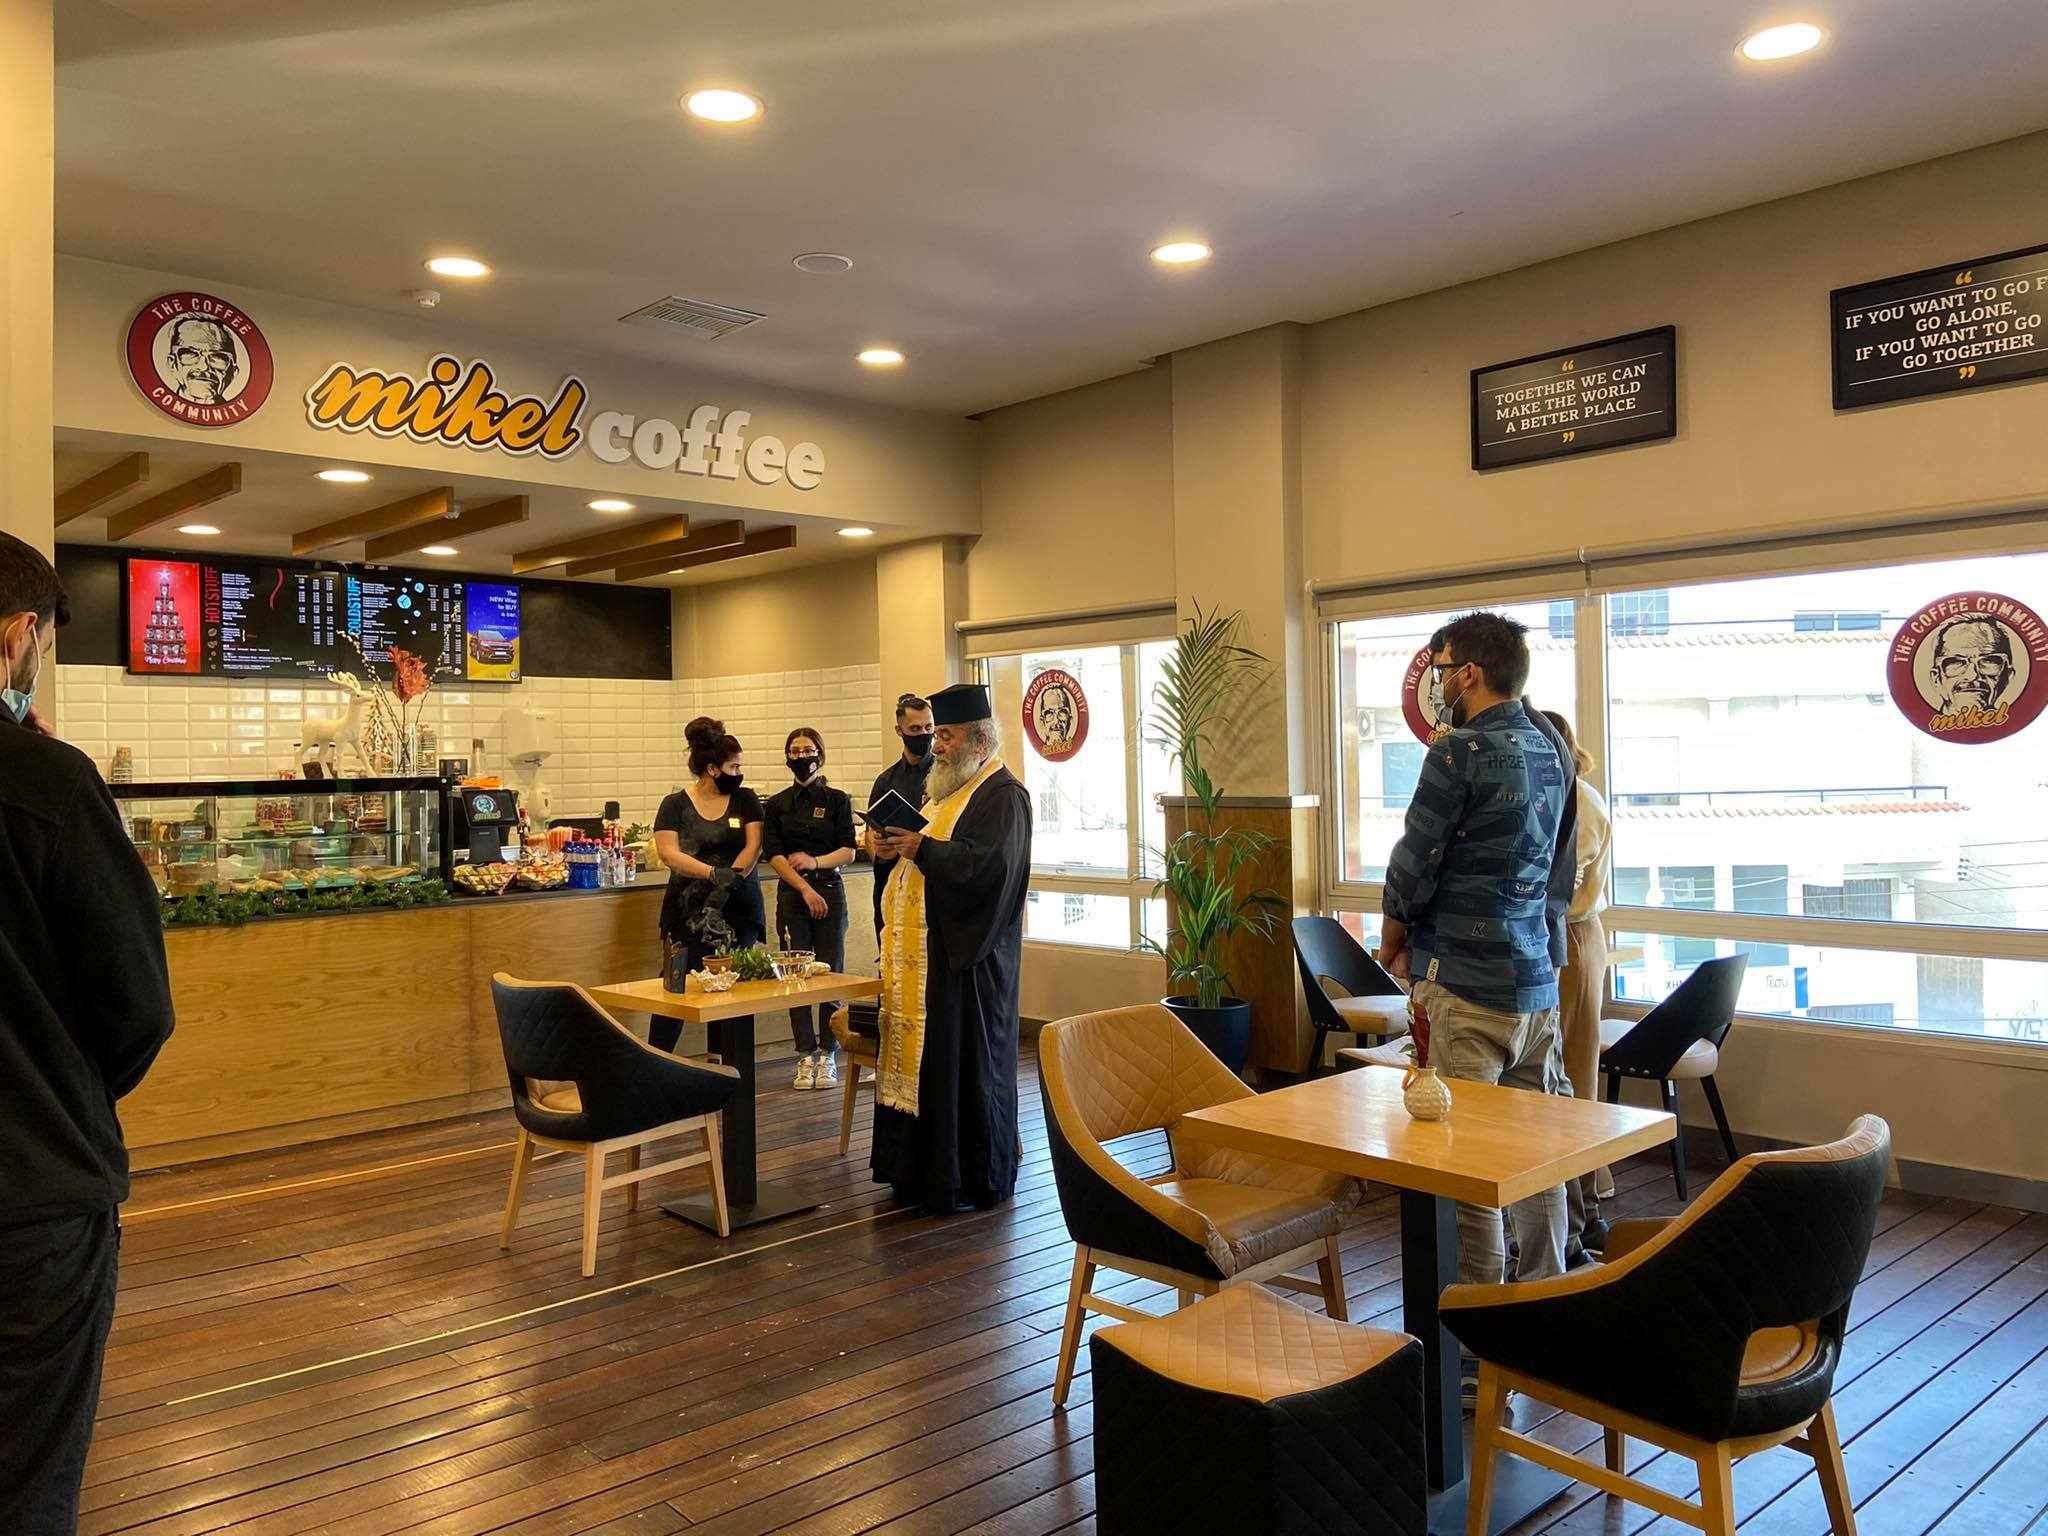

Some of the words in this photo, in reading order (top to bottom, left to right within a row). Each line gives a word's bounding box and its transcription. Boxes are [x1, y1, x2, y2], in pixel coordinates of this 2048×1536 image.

[152, 299, 183, 321] THE
[191, 297, 252, 336] COFFEE
[1845, 315, 1863, 330] IF
[1867, 306, 1904, 325] YOU
[1909, 293, 1967, 316] WANT
[1971, 287, 1997, 303] TO
[2003, 280, 2030, 297] GO
[2036, 276, 2048, 290] F
[1915, 316, 1941, 332] GO
[1946, 302, 2018, 327] ALONE,
[1855, 346, 1873, 361] IF
[1877, 338, 1915, 357] YOU
[1920, 326, 1978, 347] WANT
[1983, 320, 2009, 336] TO
[2014, 314, 2042, 331] GO
[1902, 354, 1928, 370] GO
[1932, 333, 2035, 364] TOGETHER
[1494, 379, 1577, 406] TOGETHER
[1581, 372, 1607, 388] WE
[1612, 363, 1648, 382] CAN
[1496, 401, 1541, 421] MAKE
[1545, 394, 1577, 411] THE
[1581, 381, 1642, 403] WORLD
[152, 386, 250, 423] COMMUNITY
[305, 353, 591, 459] mikel
[588, 404, 826, 491] coffee
[1505, 421, 1516, 434] A
[1520, 408, 1580, 431] BETTER
[1584, 397, 1636, 419] PLACE
[1893, 634, 1917, 664] THE
[1910, 597, 1969, 634] COFFEE
[1976, 596, 2048, 662] COMMUNITY
[1029, 673, 1053, 696] COFFEE
[1405, 668, 1421, 691] THE
[1929, 701, 2010, 733] mikel
